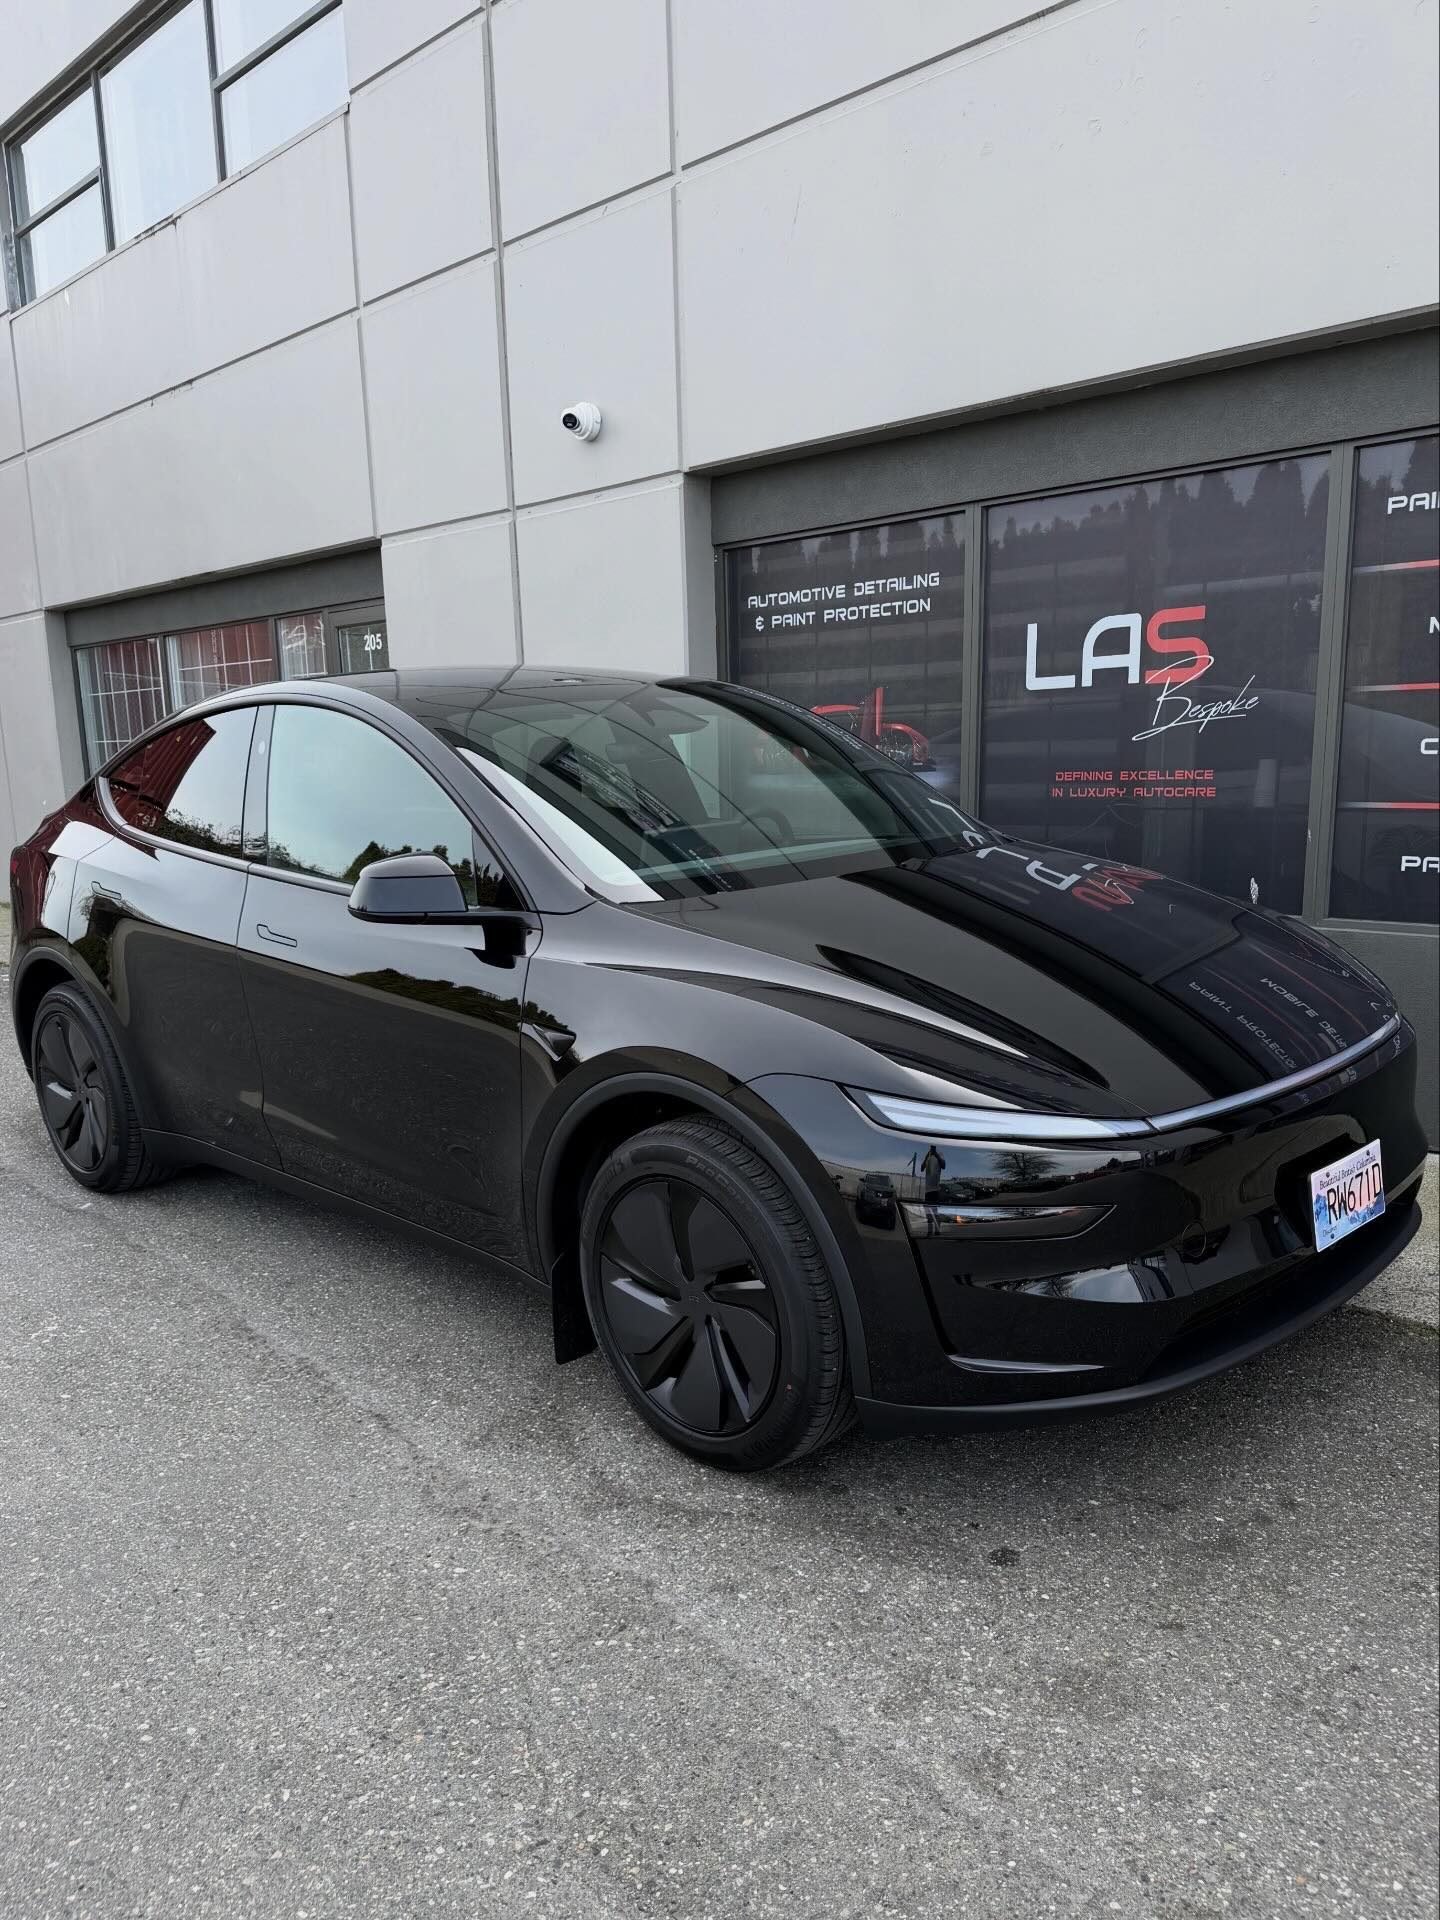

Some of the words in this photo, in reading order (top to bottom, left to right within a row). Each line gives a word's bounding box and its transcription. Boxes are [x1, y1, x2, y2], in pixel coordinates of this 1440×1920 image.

[748, 584, 846, 609] AUTOMOTIVE
[854, 571, 940, 597] DETAILING
[755, 616, 765, 632] &
[771, 611, 816, 629] PAINT
[823, 598, 931, 623] PROTECTION
[363, 633, 383, 651] 205
[1025, 605, 1210, 691] LAS
[1131, 654, 1260, 742] Bespoke
[1052, 787, 1063, 798] IN
[1069, 787, 1127, 798] LUXURY
[1133, 786, 1216, 798] AUTOCARE
[1055, 771, 1113, 782] DEFINING
[1119, 769, 1214, 781] EXCELLENCE
[1326, 1162, 1382, 1225] RW671D
